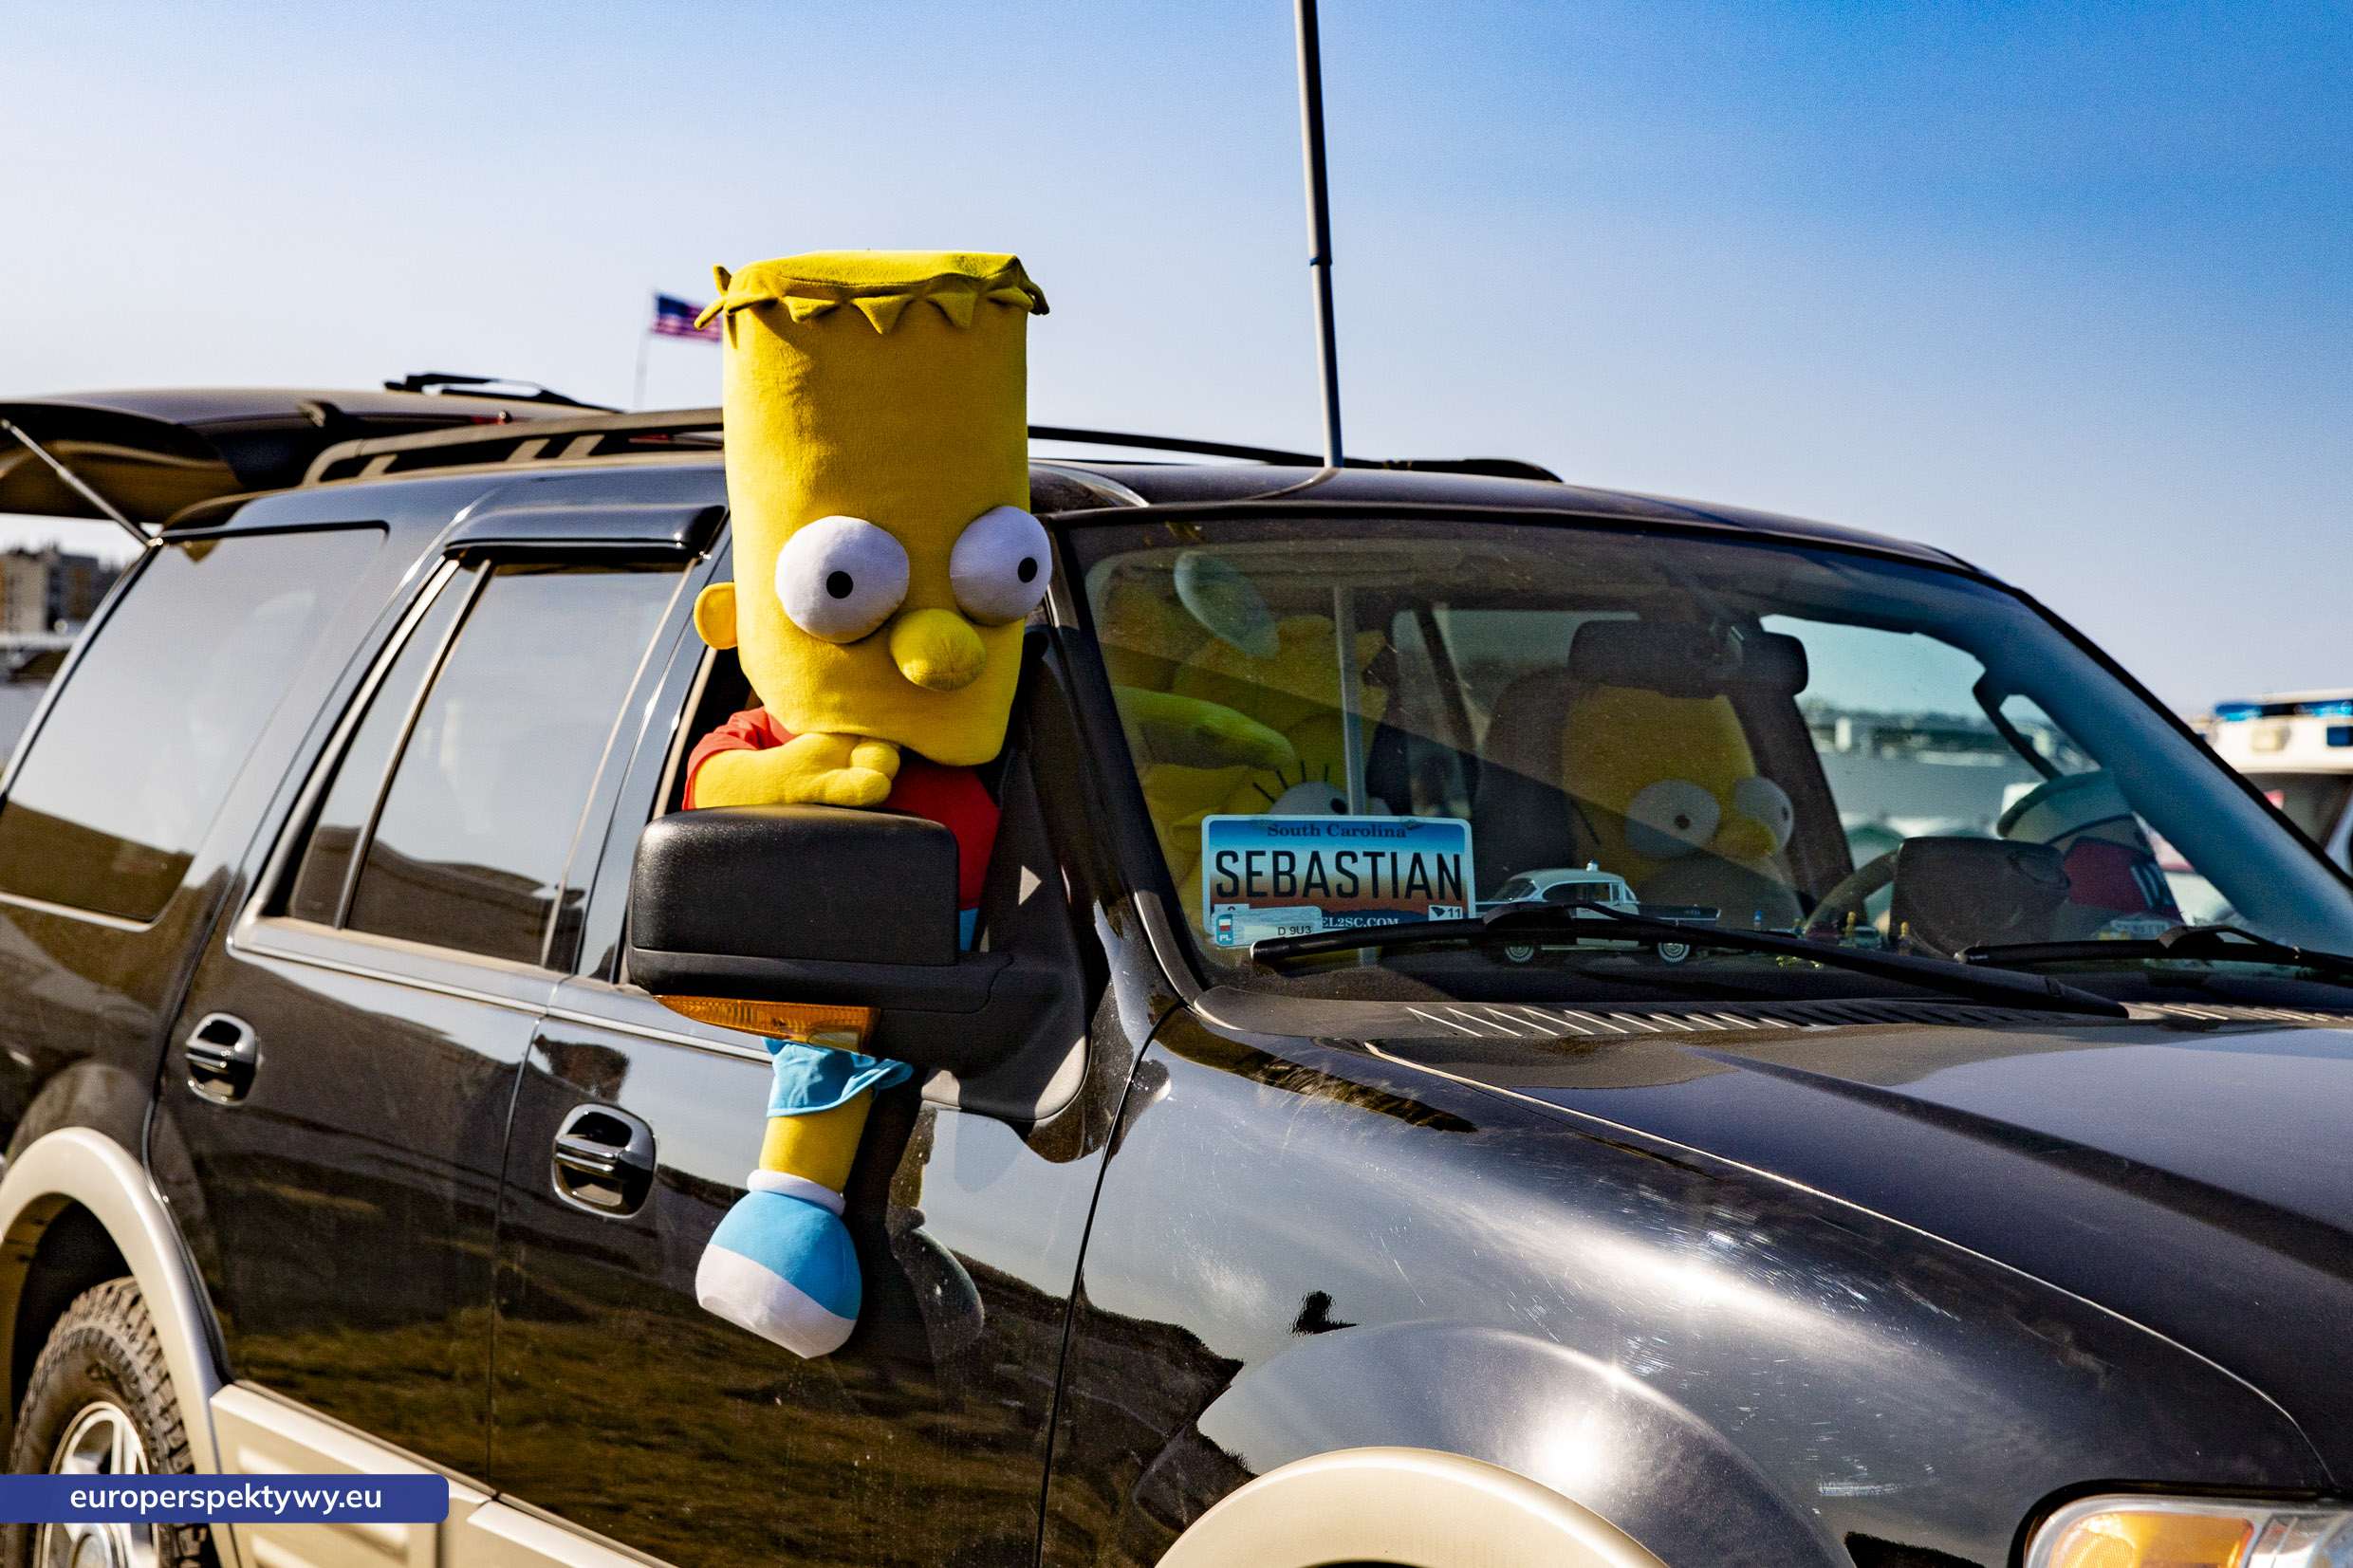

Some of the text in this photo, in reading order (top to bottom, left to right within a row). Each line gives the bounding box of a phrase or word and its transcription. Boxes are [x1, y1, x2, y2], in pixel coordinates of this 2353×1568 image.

[1267, 823, 1407, 839] South Carolina
[1215, 850, 1463, 901] SEBASTIAN
[1448, 907, 1461, 918] 11
[1277, 926, 1287, 936] D
[1219, 933, 1232, 942] PL
